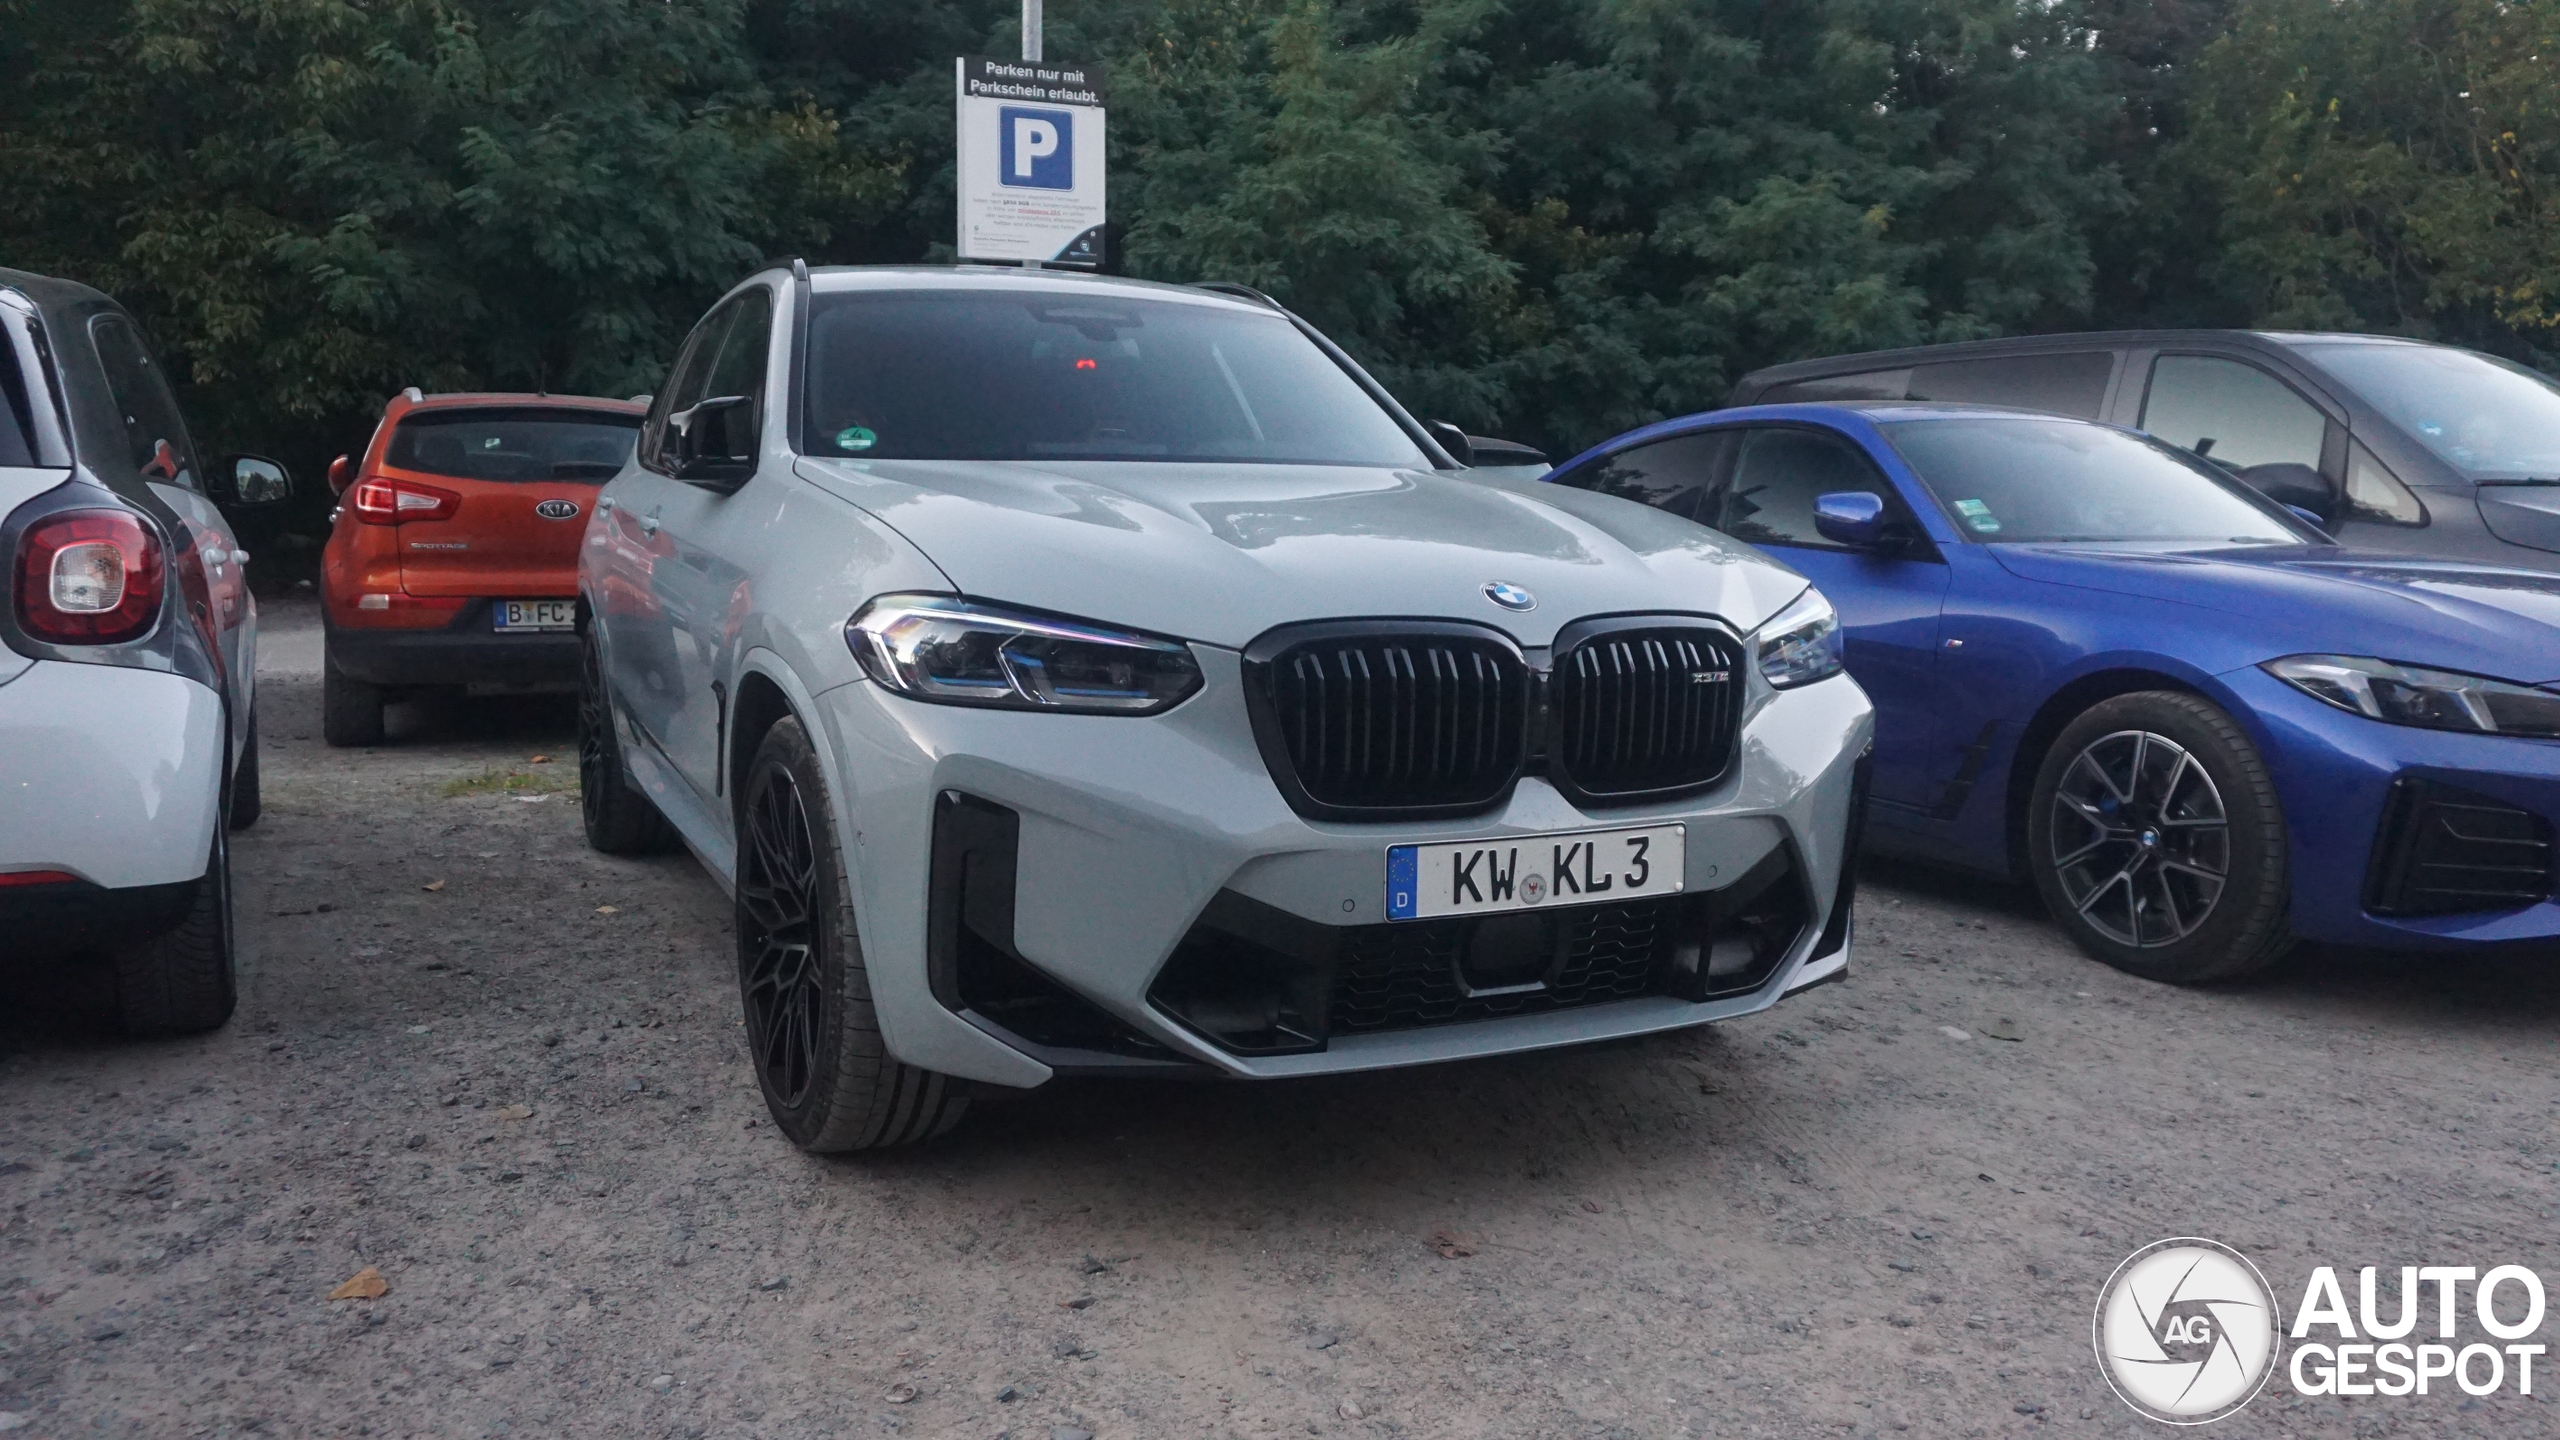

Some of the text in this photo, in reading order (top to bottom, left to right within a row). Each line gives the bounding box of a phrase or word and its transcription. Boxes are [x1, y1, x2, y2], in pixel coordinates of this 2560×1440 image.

[986, 61, 1084, 82] Parken nur mit
[970, 79, 1099, 102] Parkschein erlaubt.
[1015, 117, 1058, 176] P
[543, 503, 572, 515] KIA
[410, 542, 469, 550] SPORTAGE
[508, 604, 522, 623] B
[537, 603, 564, 623] FC
[1396, 835, 1650, 908] D KW KL 3
